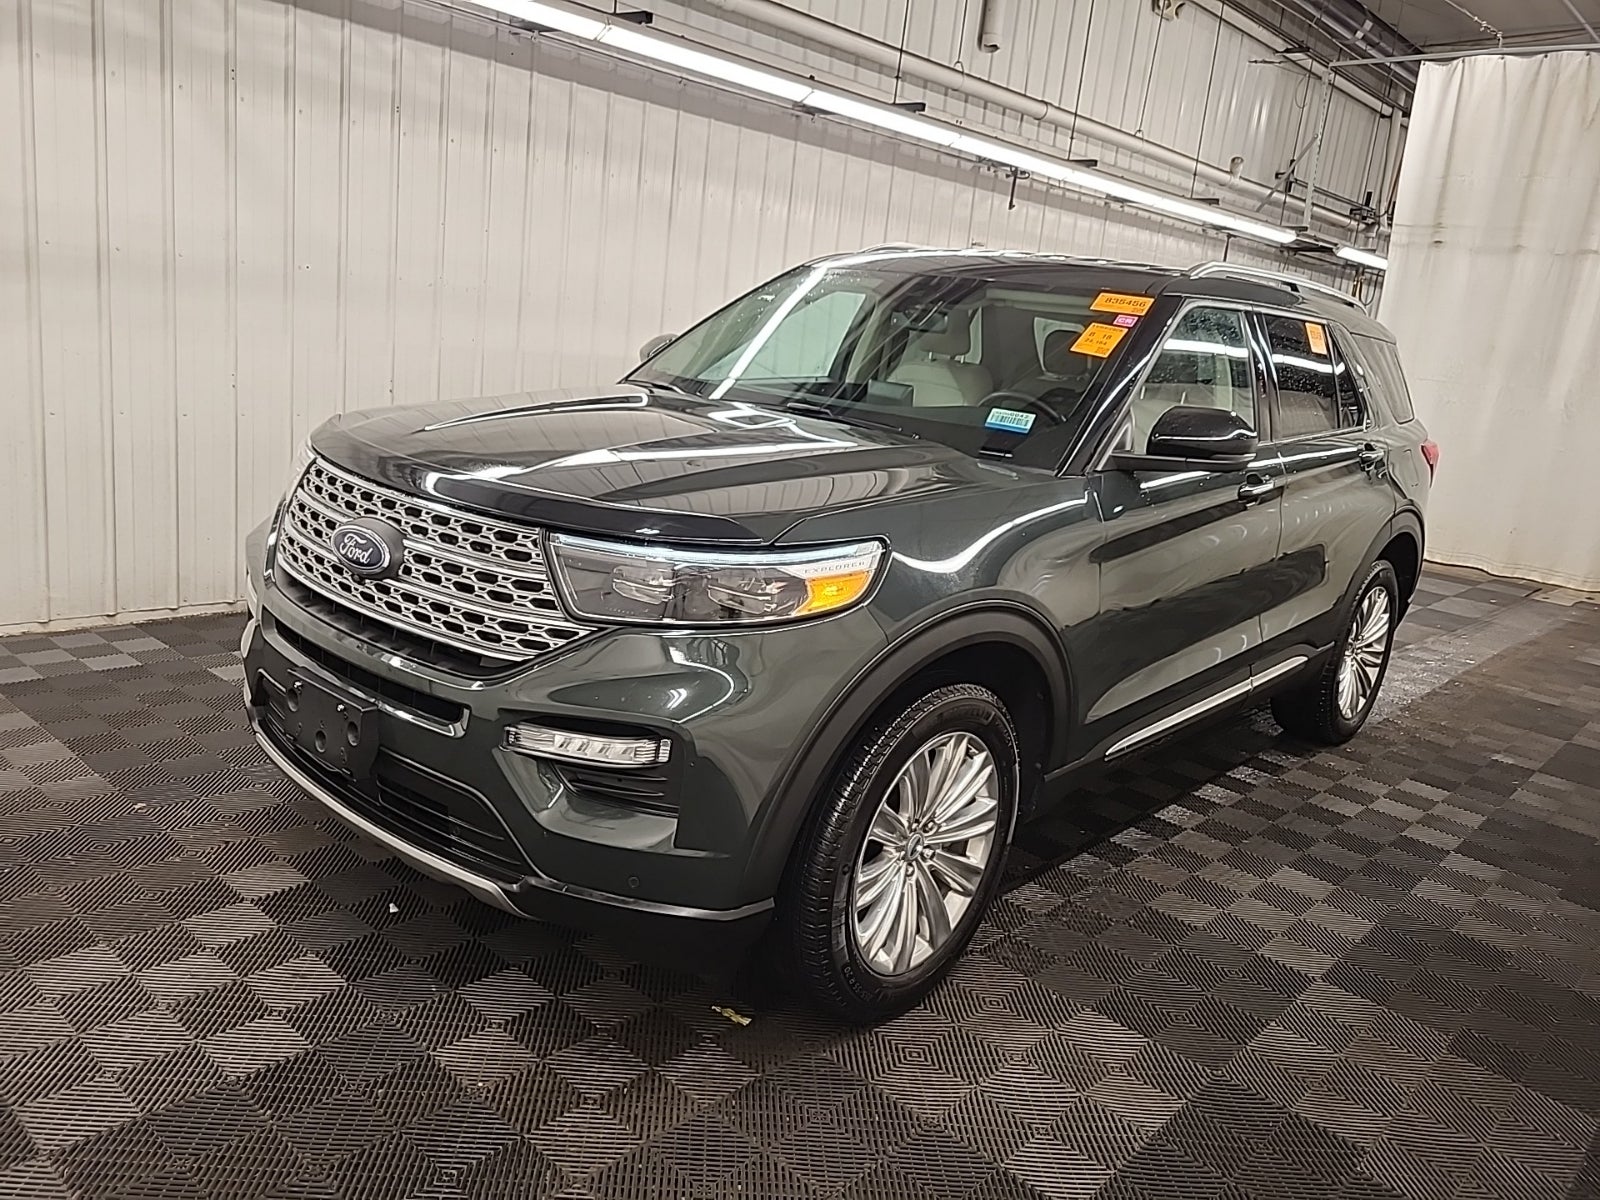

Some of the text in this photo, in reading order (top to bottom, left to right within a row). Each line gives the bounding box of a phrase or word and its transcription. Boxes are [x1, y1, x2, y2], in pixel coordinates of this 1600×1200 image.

[1104, 297, 1147, 307] 835456
[340, 533, 373, 564] Ford
[804, 561, 865, 574] EXPLORER
